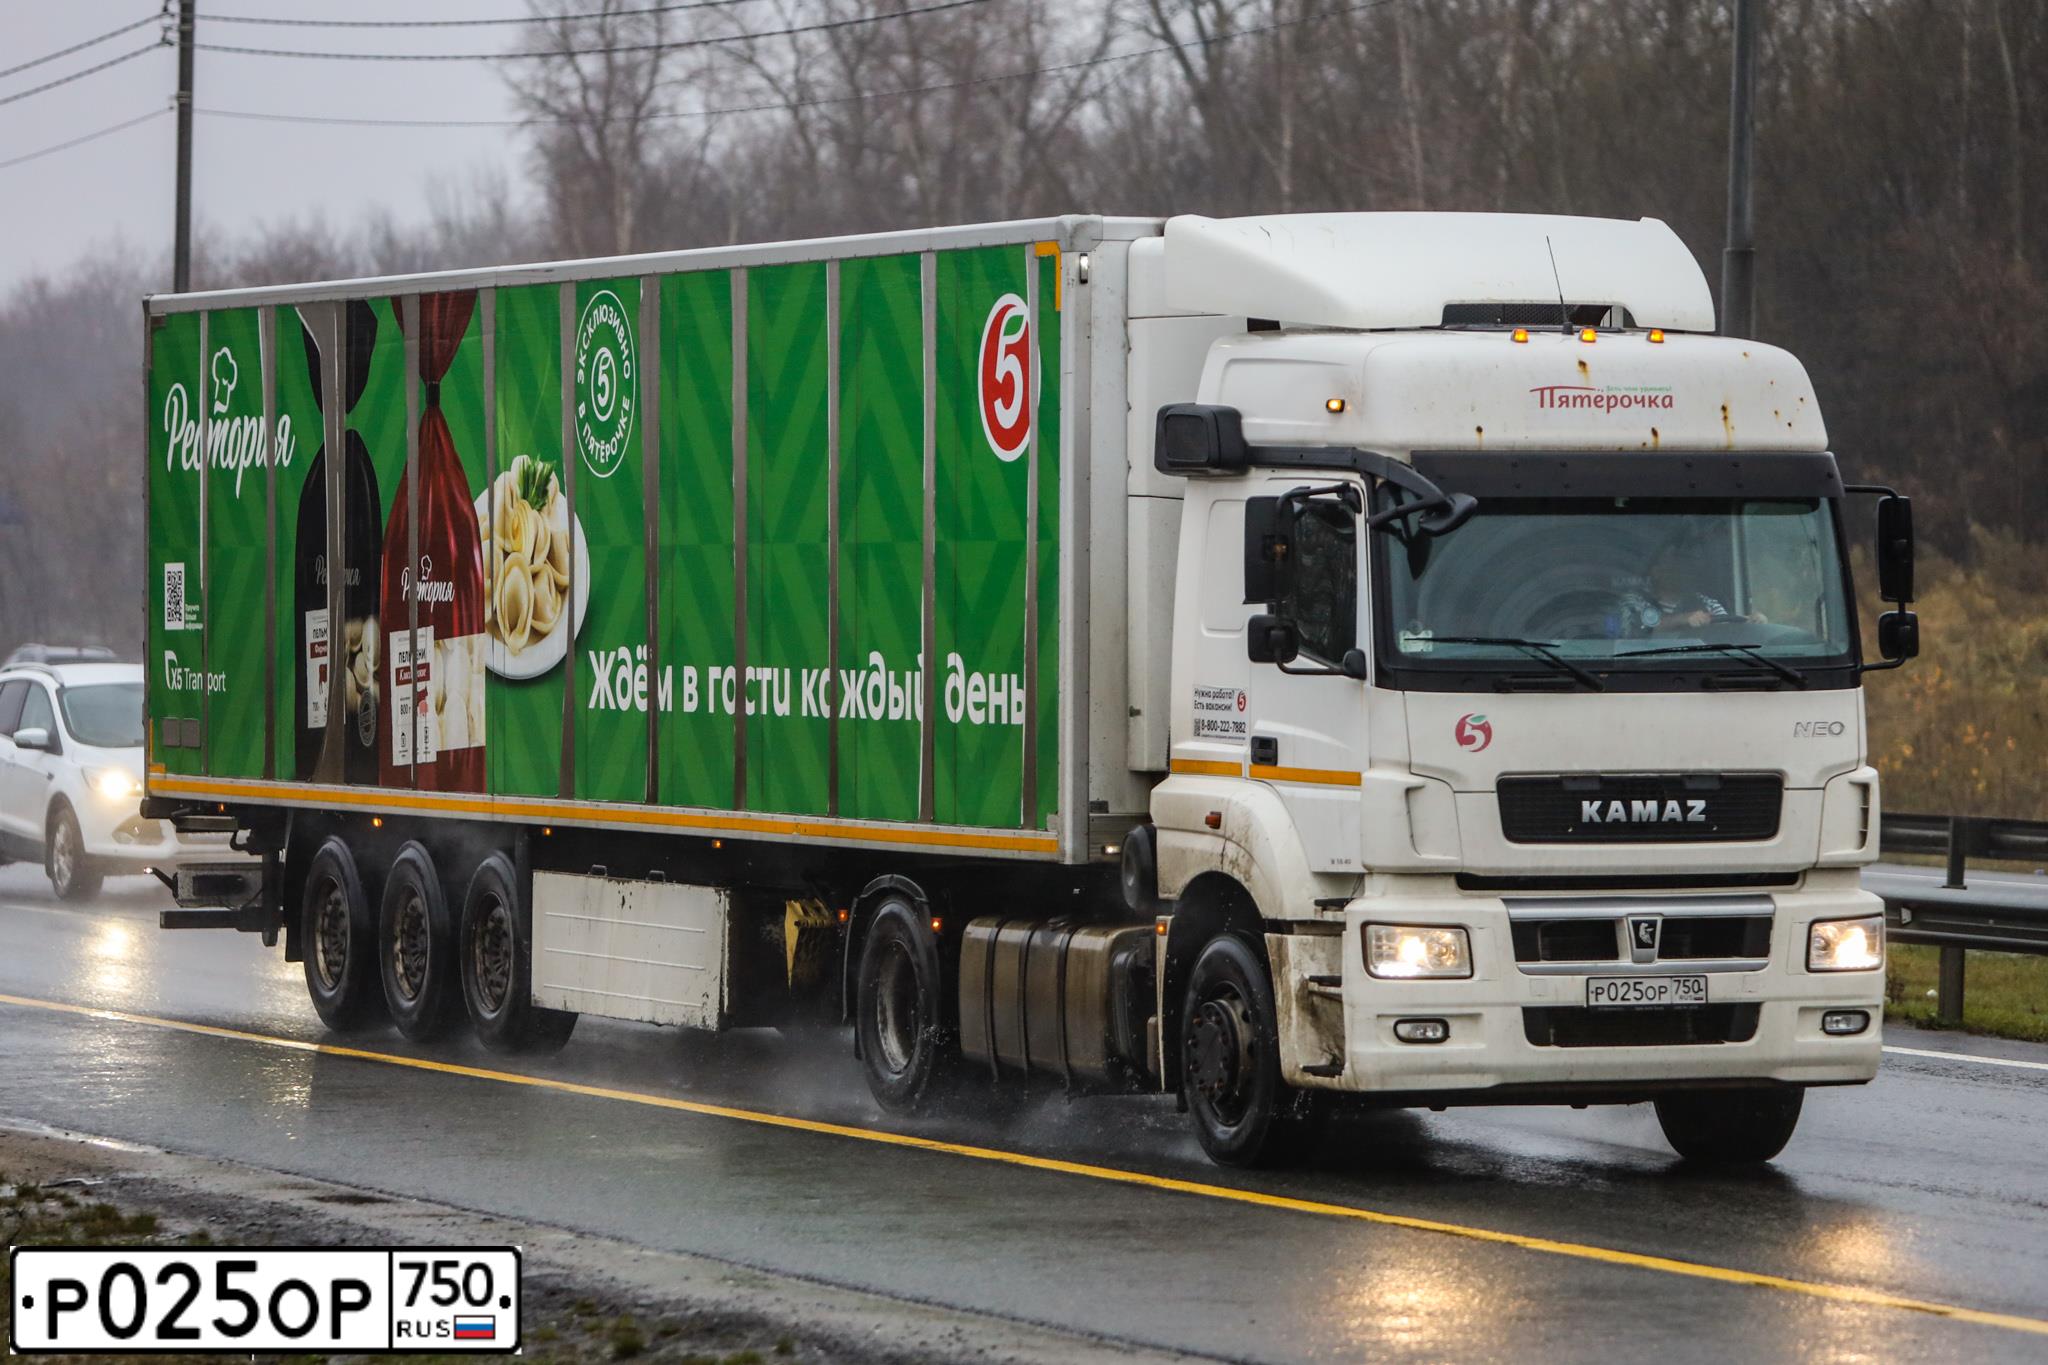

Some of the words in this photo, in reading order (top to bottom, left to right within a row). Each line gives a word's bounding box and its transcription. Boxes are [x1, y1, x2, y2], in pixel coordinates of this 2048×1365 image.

[577, 303, 631, 385] ЭКСКЛЮЗИВНО
[578, 401, 586, 419] В
[583, 395, 630, 463] ПЯТЁРОЧКЕ
[184, 667, 226, 696] Tranport
[588, 644, 673, 712] Ждём
[683, 665, 699, 713] в
[708, 666, 790, 717] гости
[944, 651, 1026, 725] день
[1793, 720, 1846, 738] NEO
[1581, 799, 1707, 823] KAMAZ
[1673, 978, 1702, 995] 750
